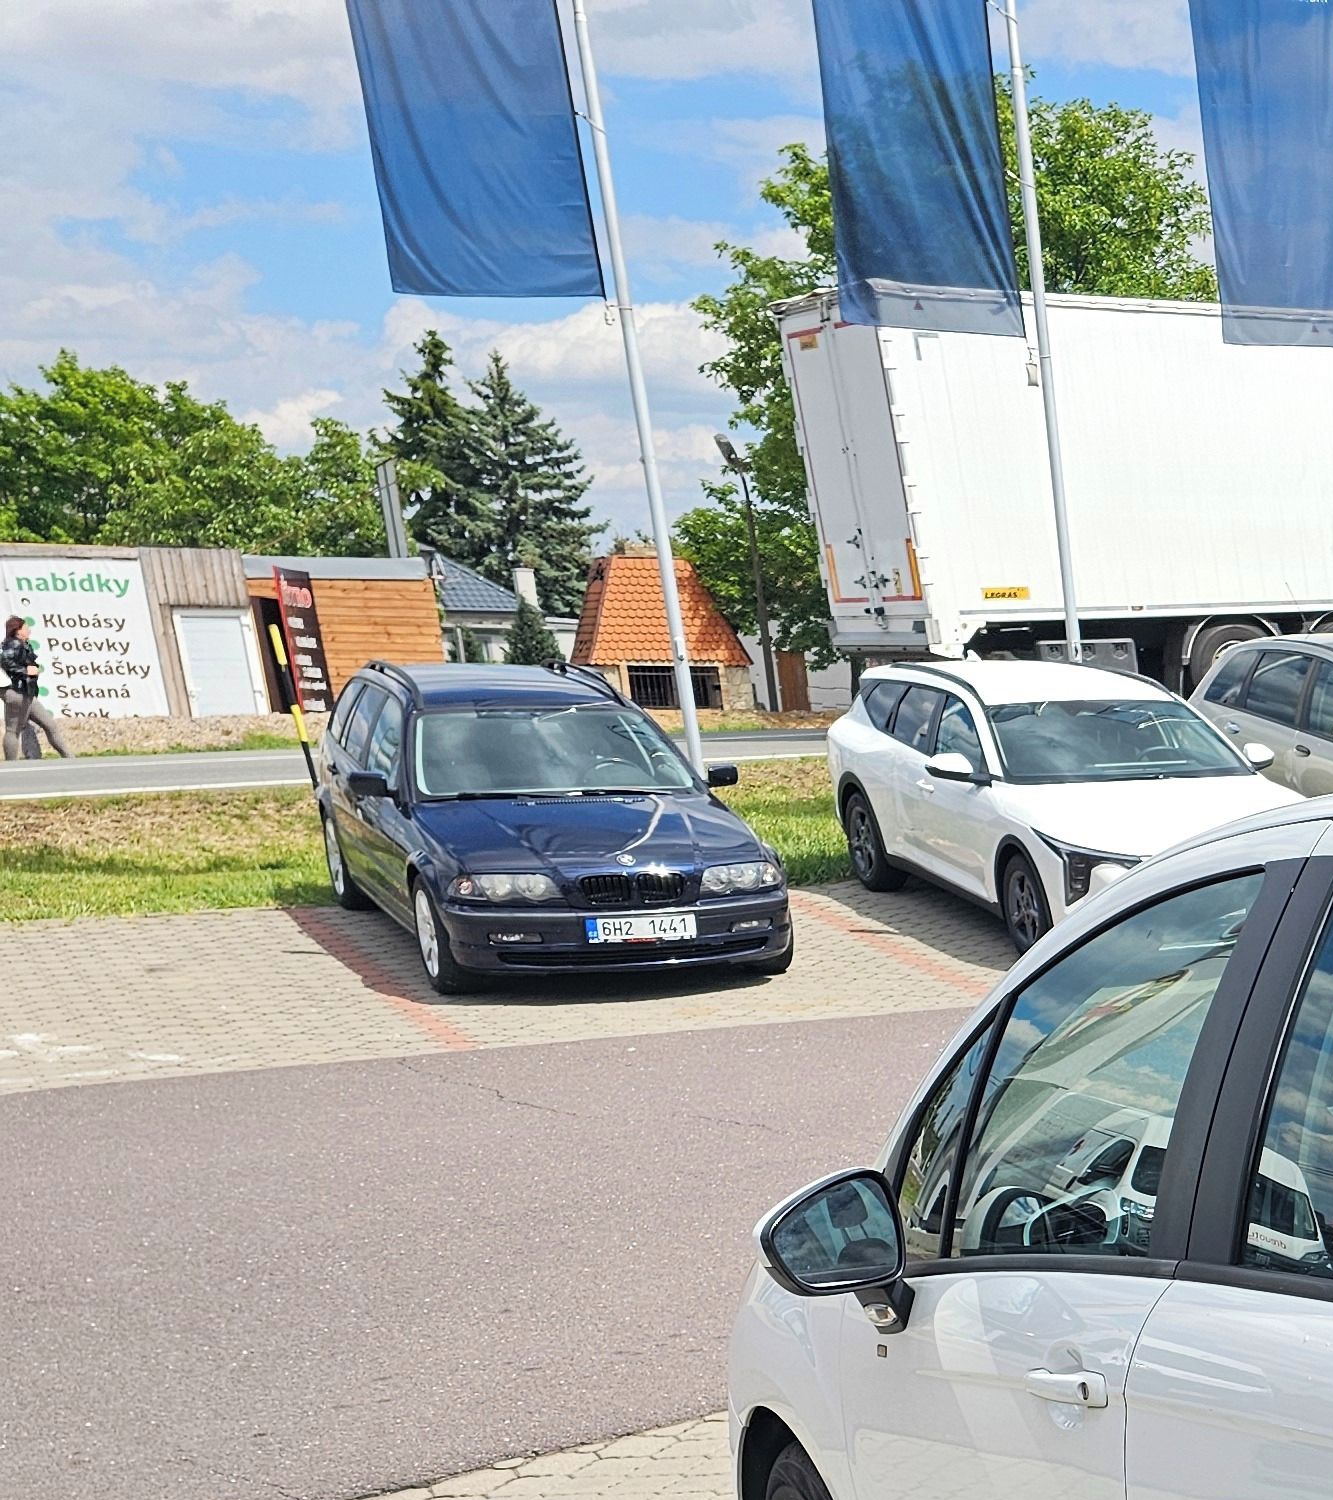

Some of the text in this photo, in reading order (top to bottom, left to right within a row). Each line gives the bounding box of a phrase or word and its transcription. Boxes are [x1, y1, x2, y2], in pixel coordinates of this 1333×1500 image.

[16, 572, 130, 598] nabídky
[42, 613, 126, 632] Klobásy
[47, 637, 130, 655] Polévky
[52, 657, 151, 679] Špekáčky
[56, 684, 131, 699] Sekaná
[602, 917, 687, 937] 6H2 1441
